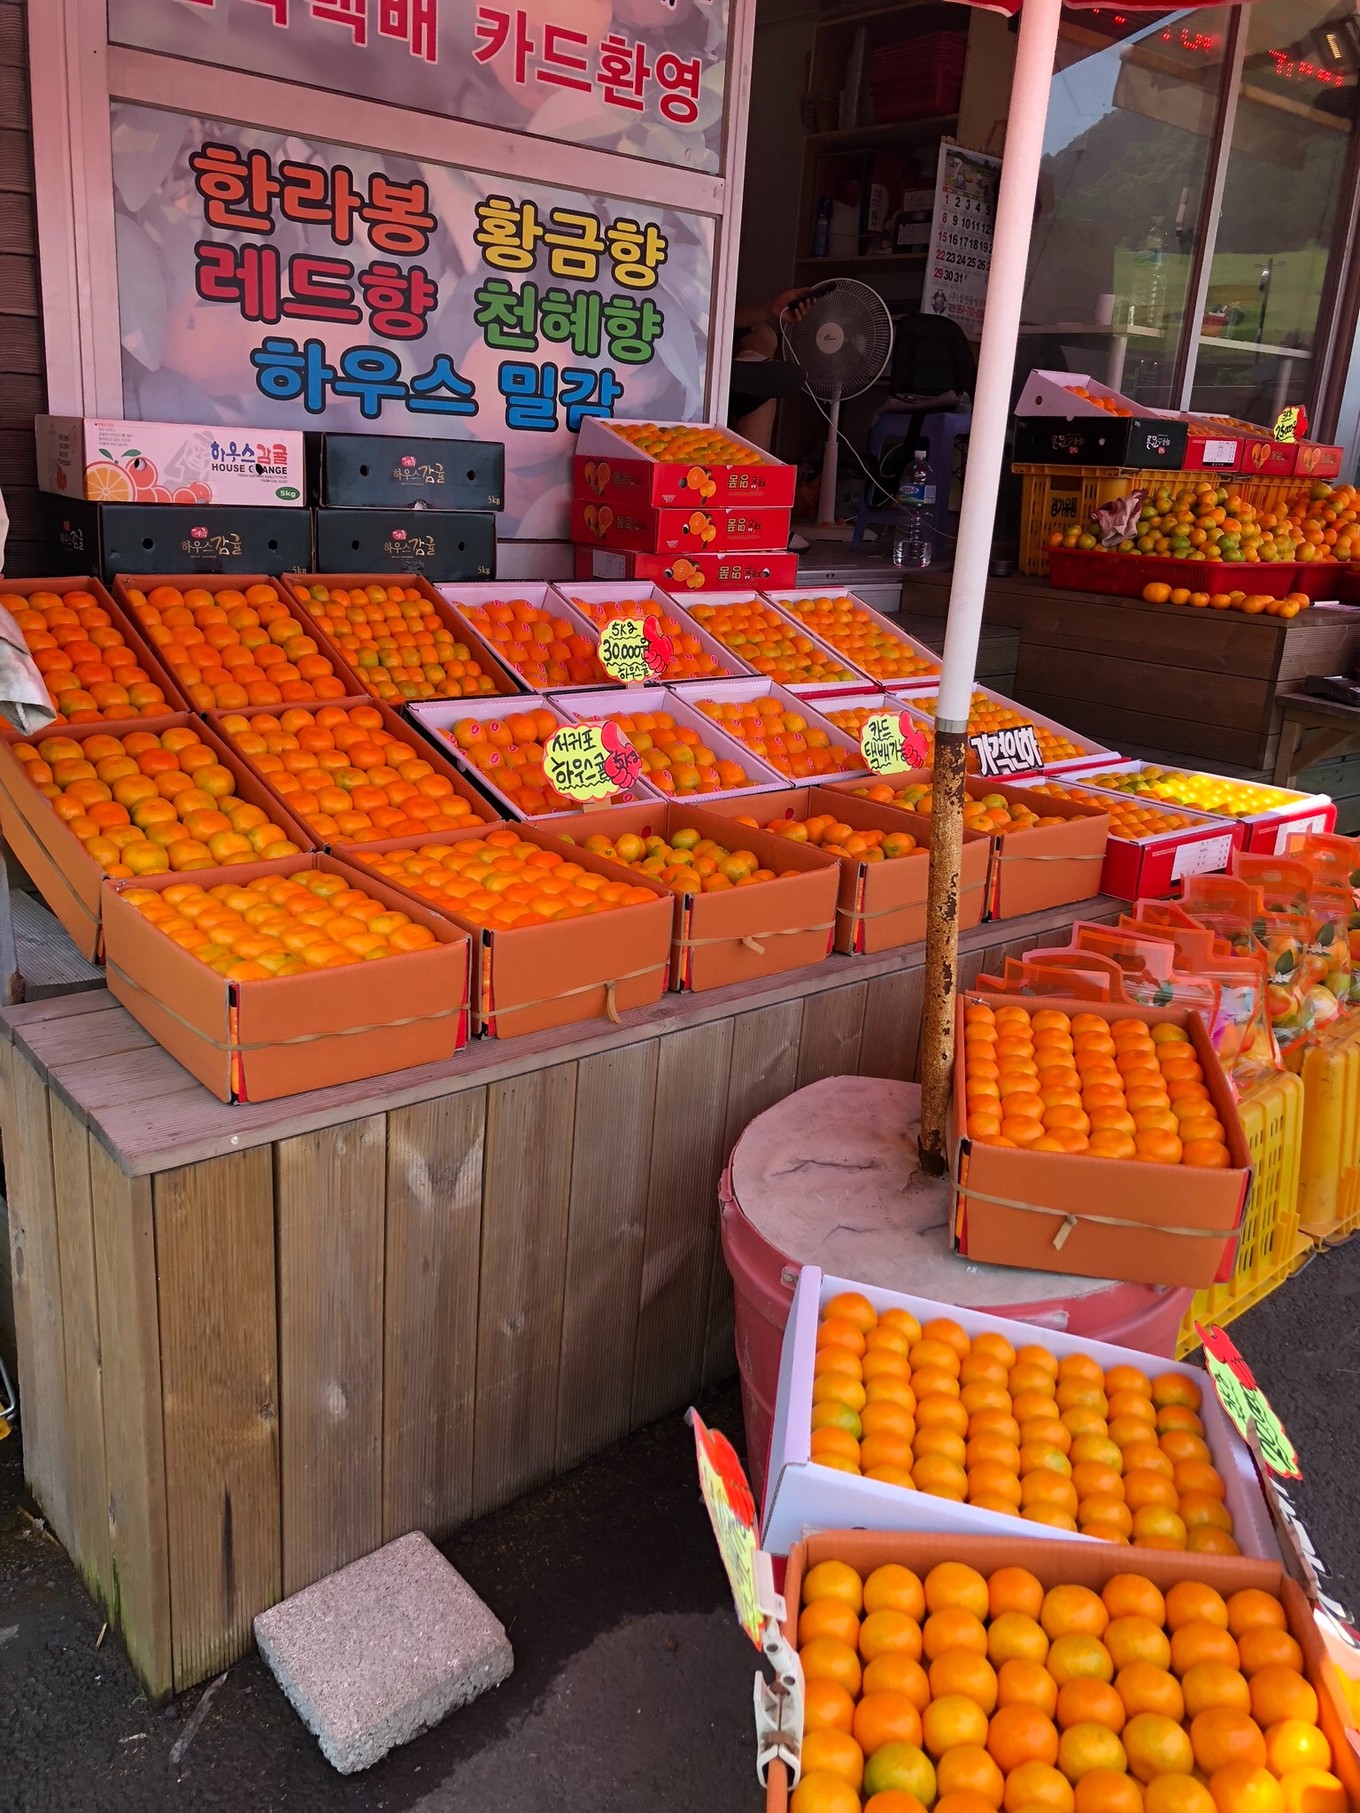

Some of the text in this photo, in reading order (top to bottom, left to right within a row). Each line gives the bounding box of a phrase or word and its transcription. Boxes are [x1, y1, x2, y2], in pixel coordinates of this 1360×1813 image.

[189, 142, 437, 257] 한라봉
[955, 197, 960, 208] 2
[965, 200, 971, 210] 3
[975, 203, 981, 214] 4
[953, 215, 958, 226] 9
[962, 218, 971, 229] 10
[972, 221, 980, 232] 11
[982, 224, 991, 235] 12
[475, 194, 668, 291] 황금향
[938, 231, 947, 243] 15
[949, 233, 958, 245] 16
[960, 236, 969, 247] 17
[970, 239, 979, 250] 18
[980, 242, 988, 253] 19
[936, 249, 946, 261] 22
[946, 252, 956, 263] 23
[956, 254, 966, 265] 24
[967, 257, 976, 268] 25
[977, 259, 986, 271] 26
[934, 267, 963, 283] 29 30 31
[194, 240, 438, 340] 레드향
[474, 276, 664, 364] 천혜향
[250, 337, 624, 433] 하우스 밀감
[212, 463, 245, 473] HOUSE
[280, 491, 296, 499] 5kg
[488, 495, 501, 506] 5kg
[477, 565, 491, 576] 5kg
[868, 719, 892, 739] 카드
[553, 729, 597, 753] 서귀포
[971, 726, 1044, 776] 가격인하
